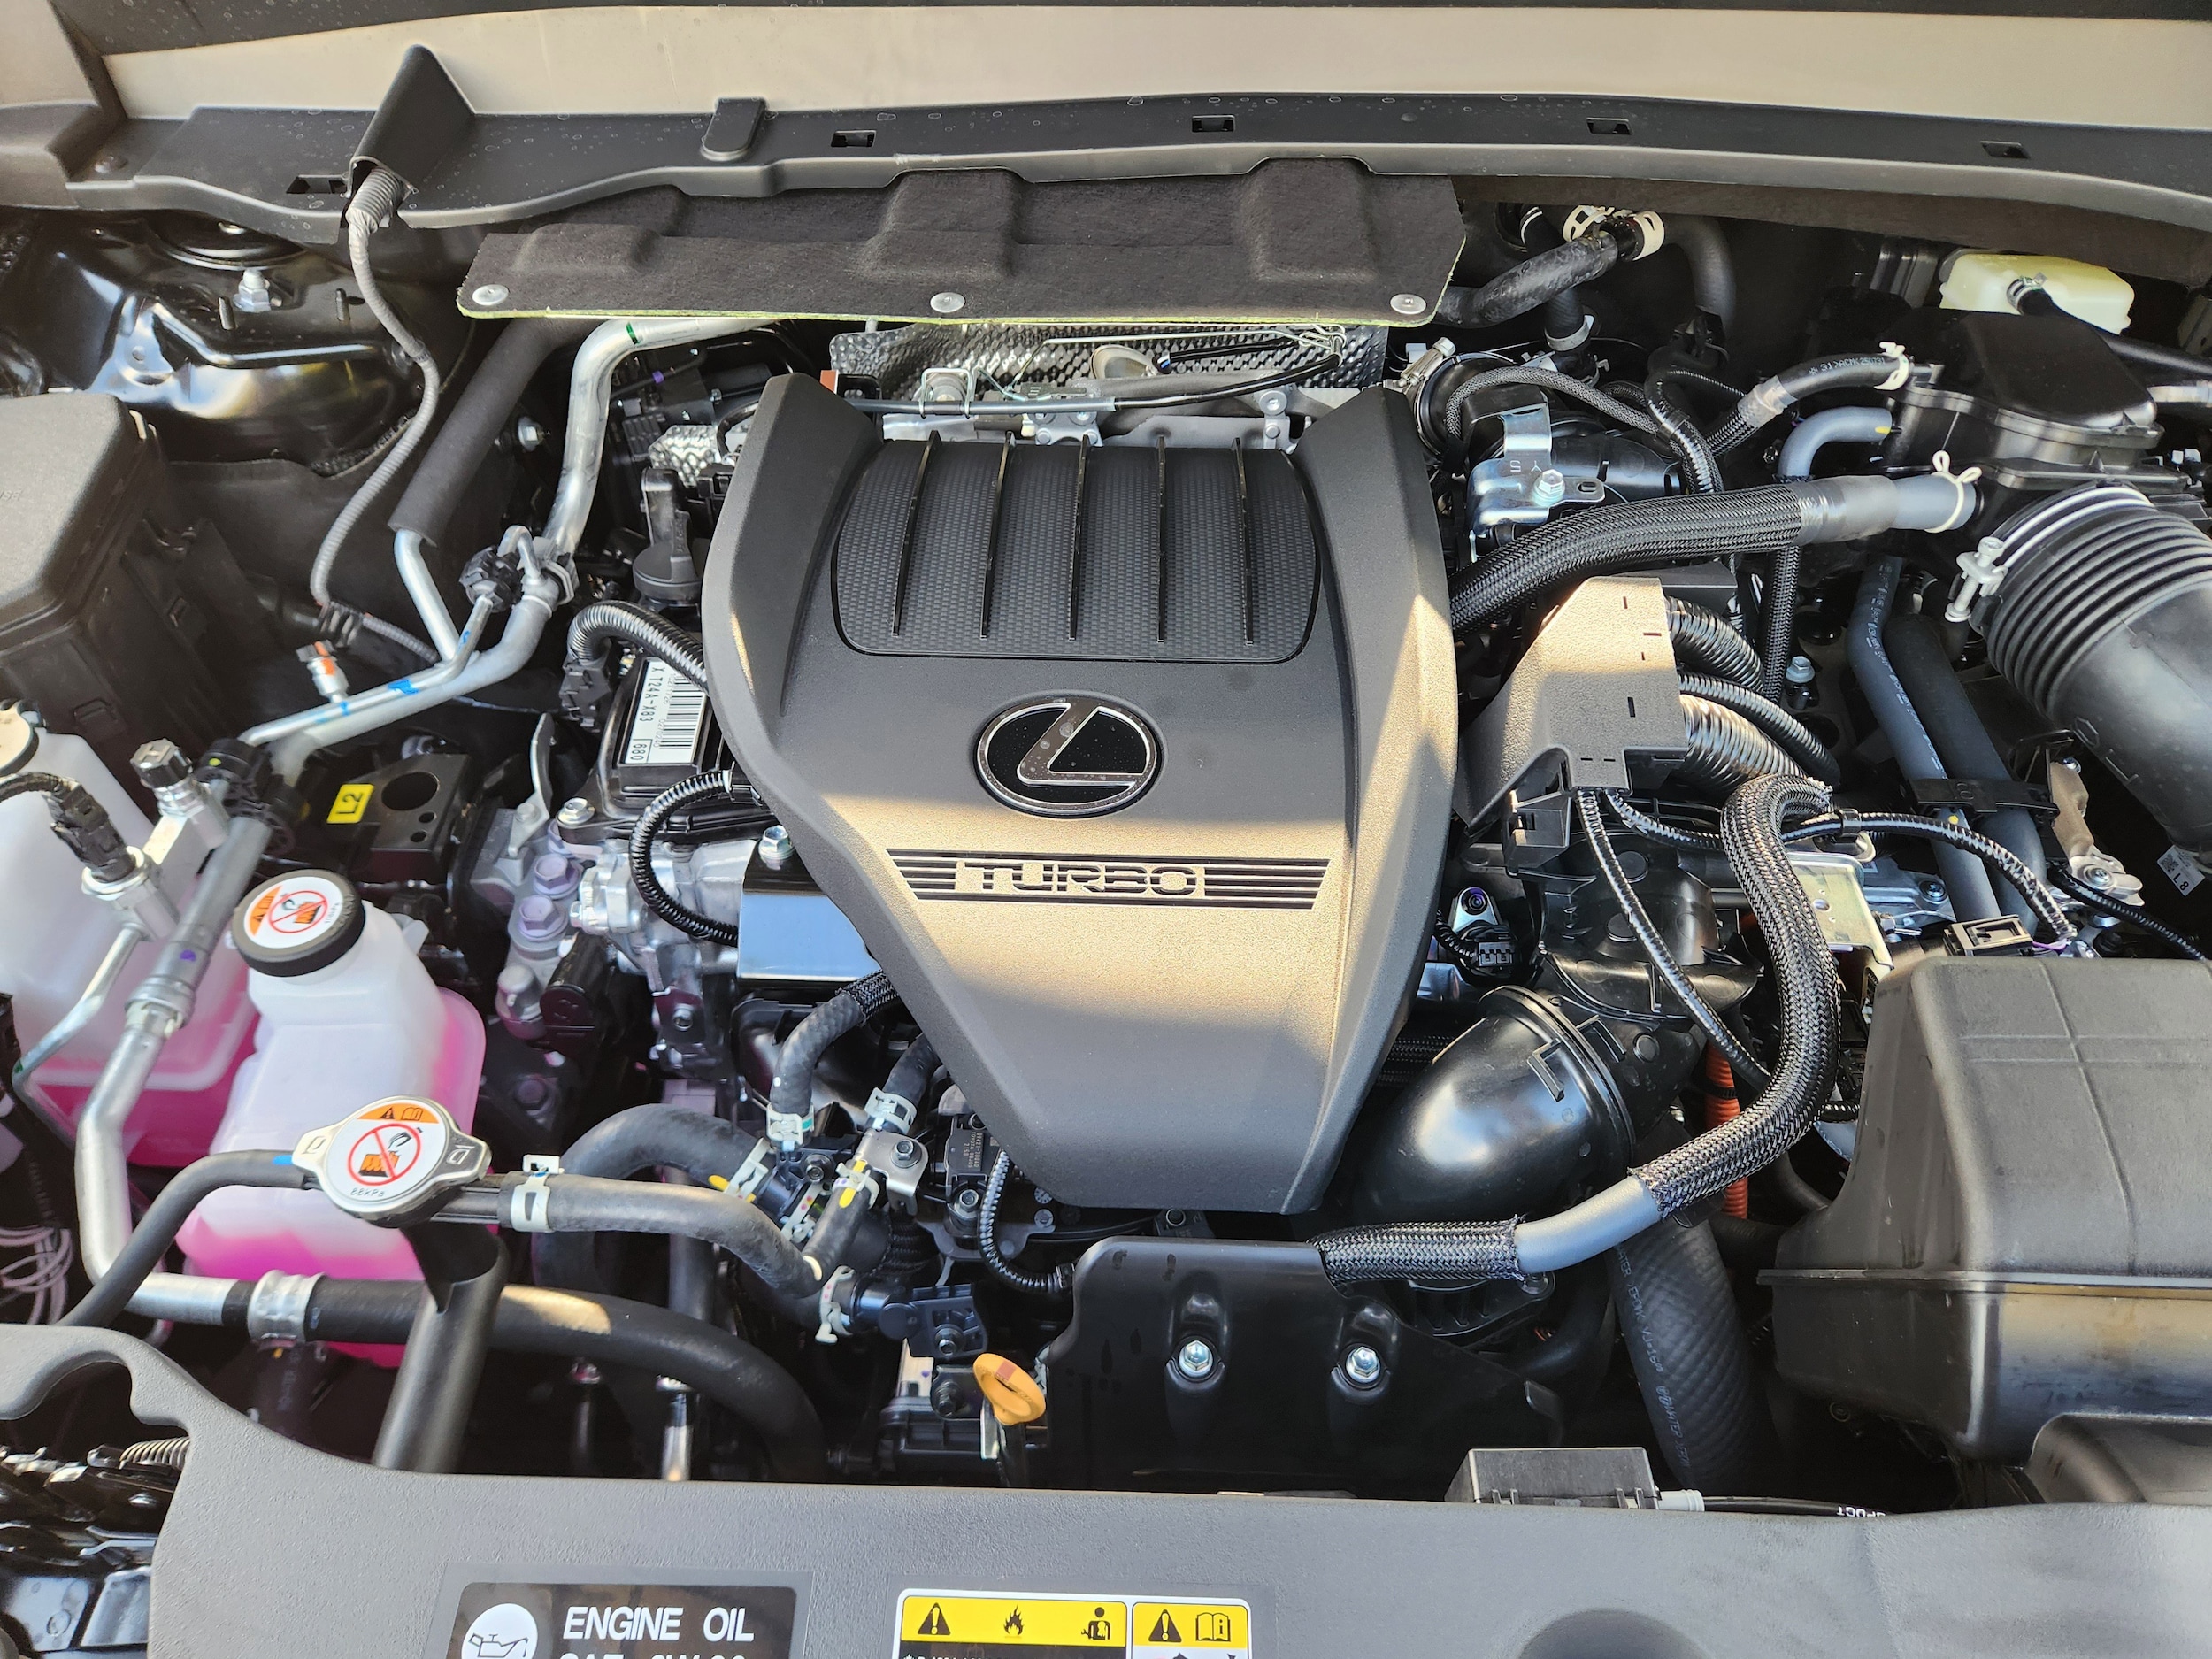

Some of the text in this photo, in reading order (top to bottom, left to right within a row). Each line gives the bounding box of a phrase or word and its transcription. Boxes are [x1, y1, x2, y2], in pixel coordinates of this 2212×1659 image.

[630, 743, 648, 761] 680
[335, 792, 365, 814] L2
[963, 862, 1200, 897] TURBO
[562, 1606, 756, 1642] ENGINE OIL
